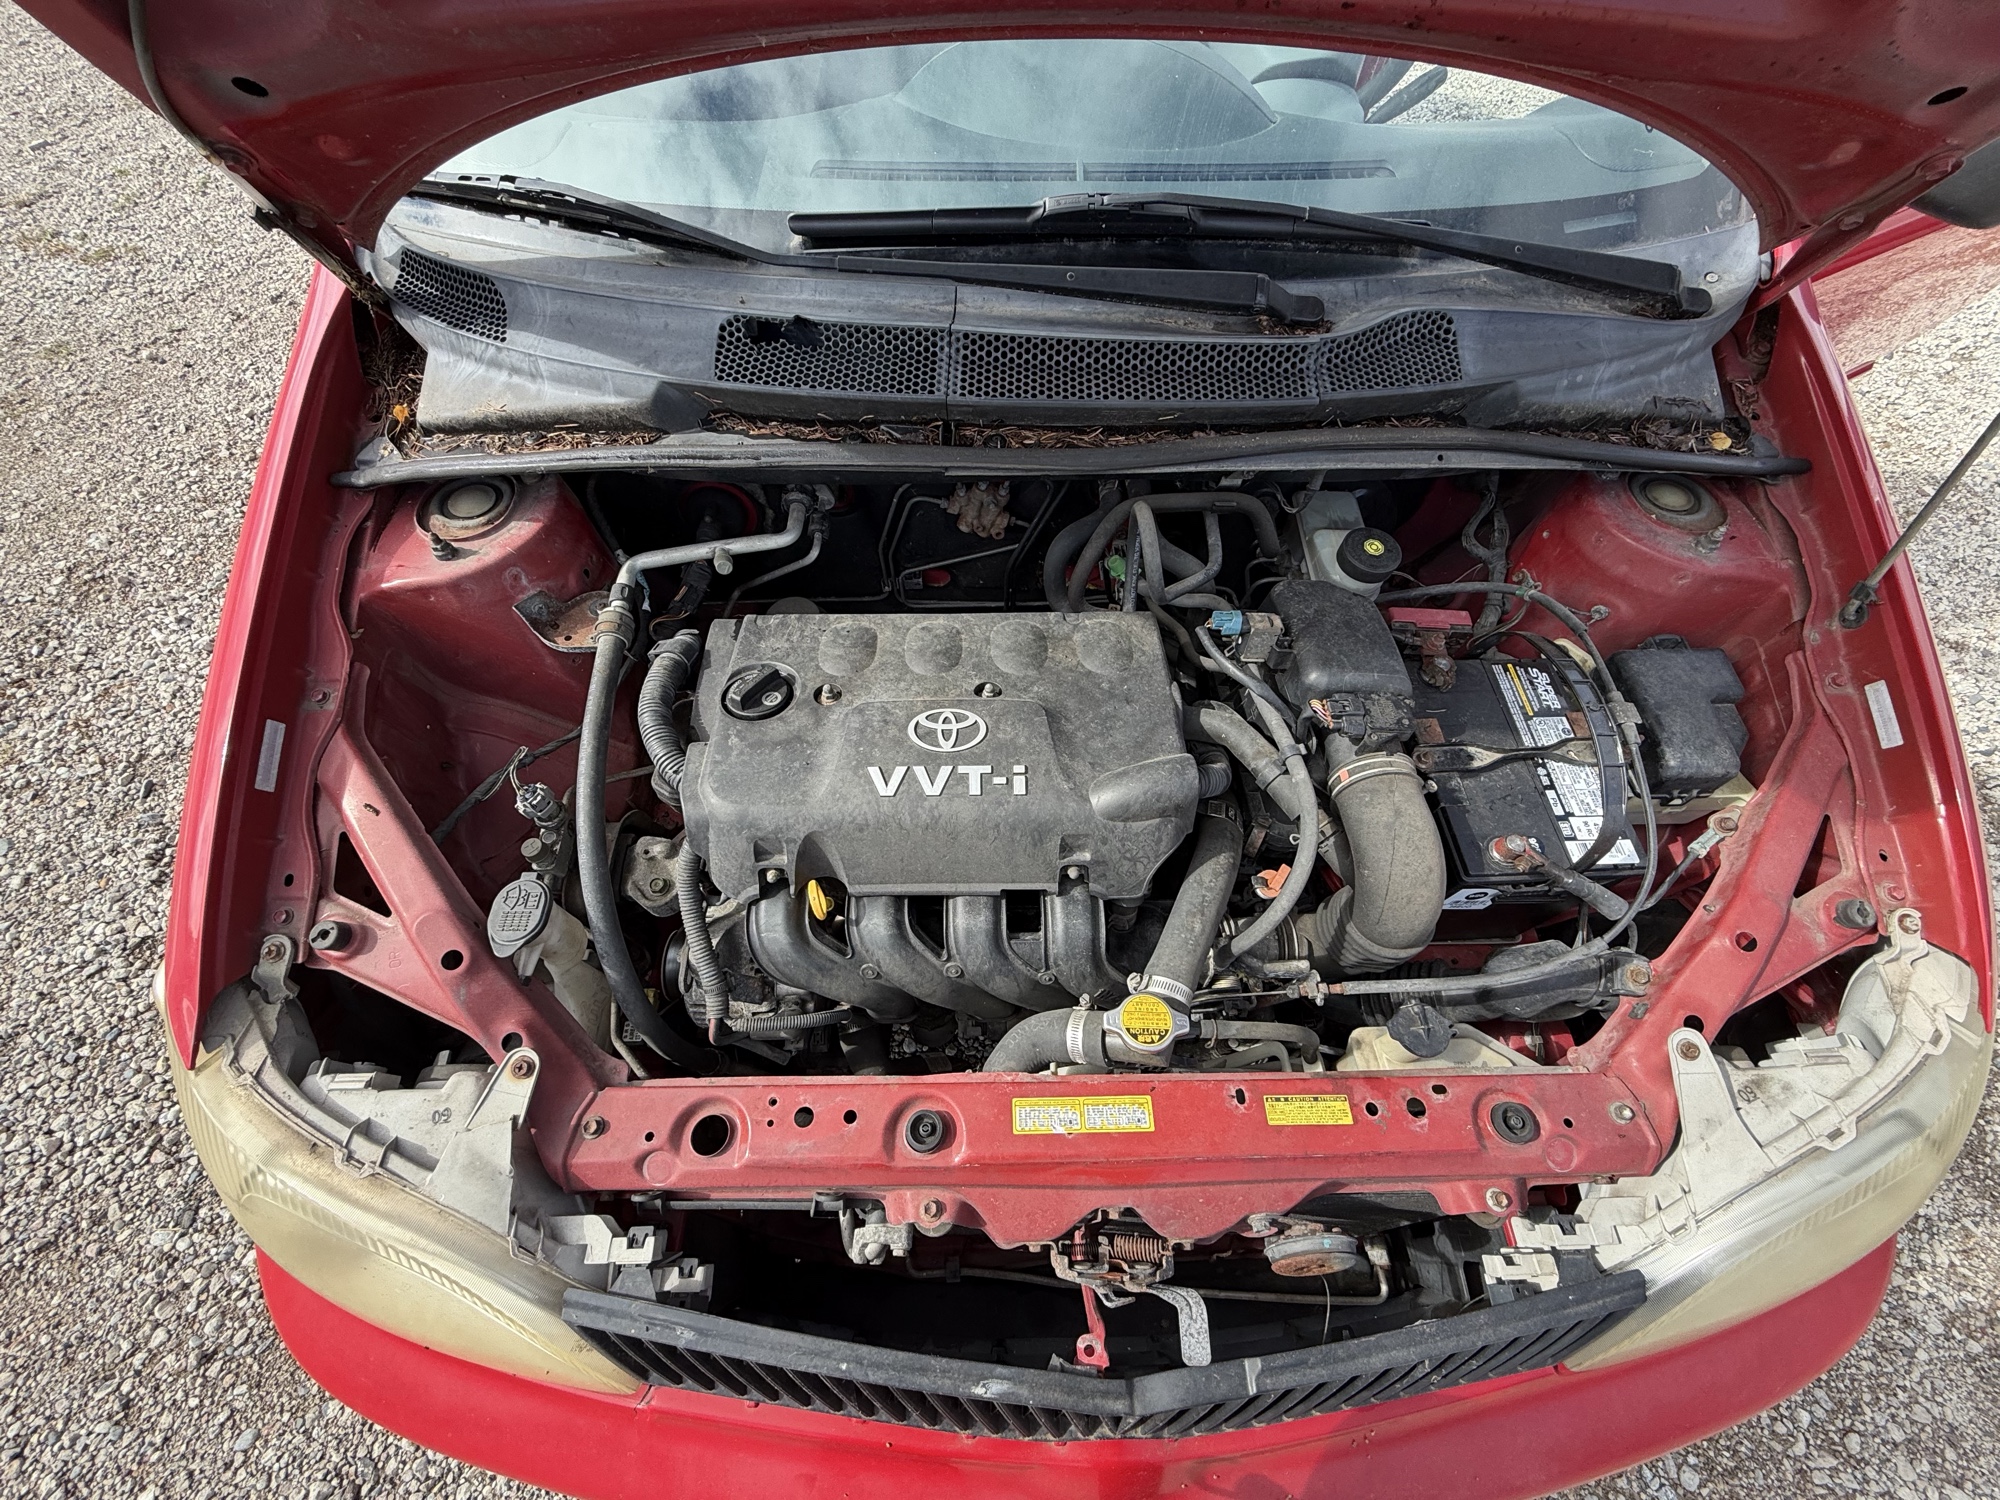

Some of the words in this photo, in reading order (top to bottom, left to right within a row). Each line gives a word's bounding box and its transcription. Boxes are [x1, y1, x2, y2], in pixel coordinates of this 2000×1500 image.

[1527, 667, 1554, 710] START
[1541, 672, 1562, 709] SUPER
[867, 764, 1029, 797] VVT-i
[1550, 797, 1559, 808] Pb
[1582, 820, 1589, 828] 90
[1585, 828, 1594, 837] RC
[1130, 1028, 1165, 1036] CAUTION
